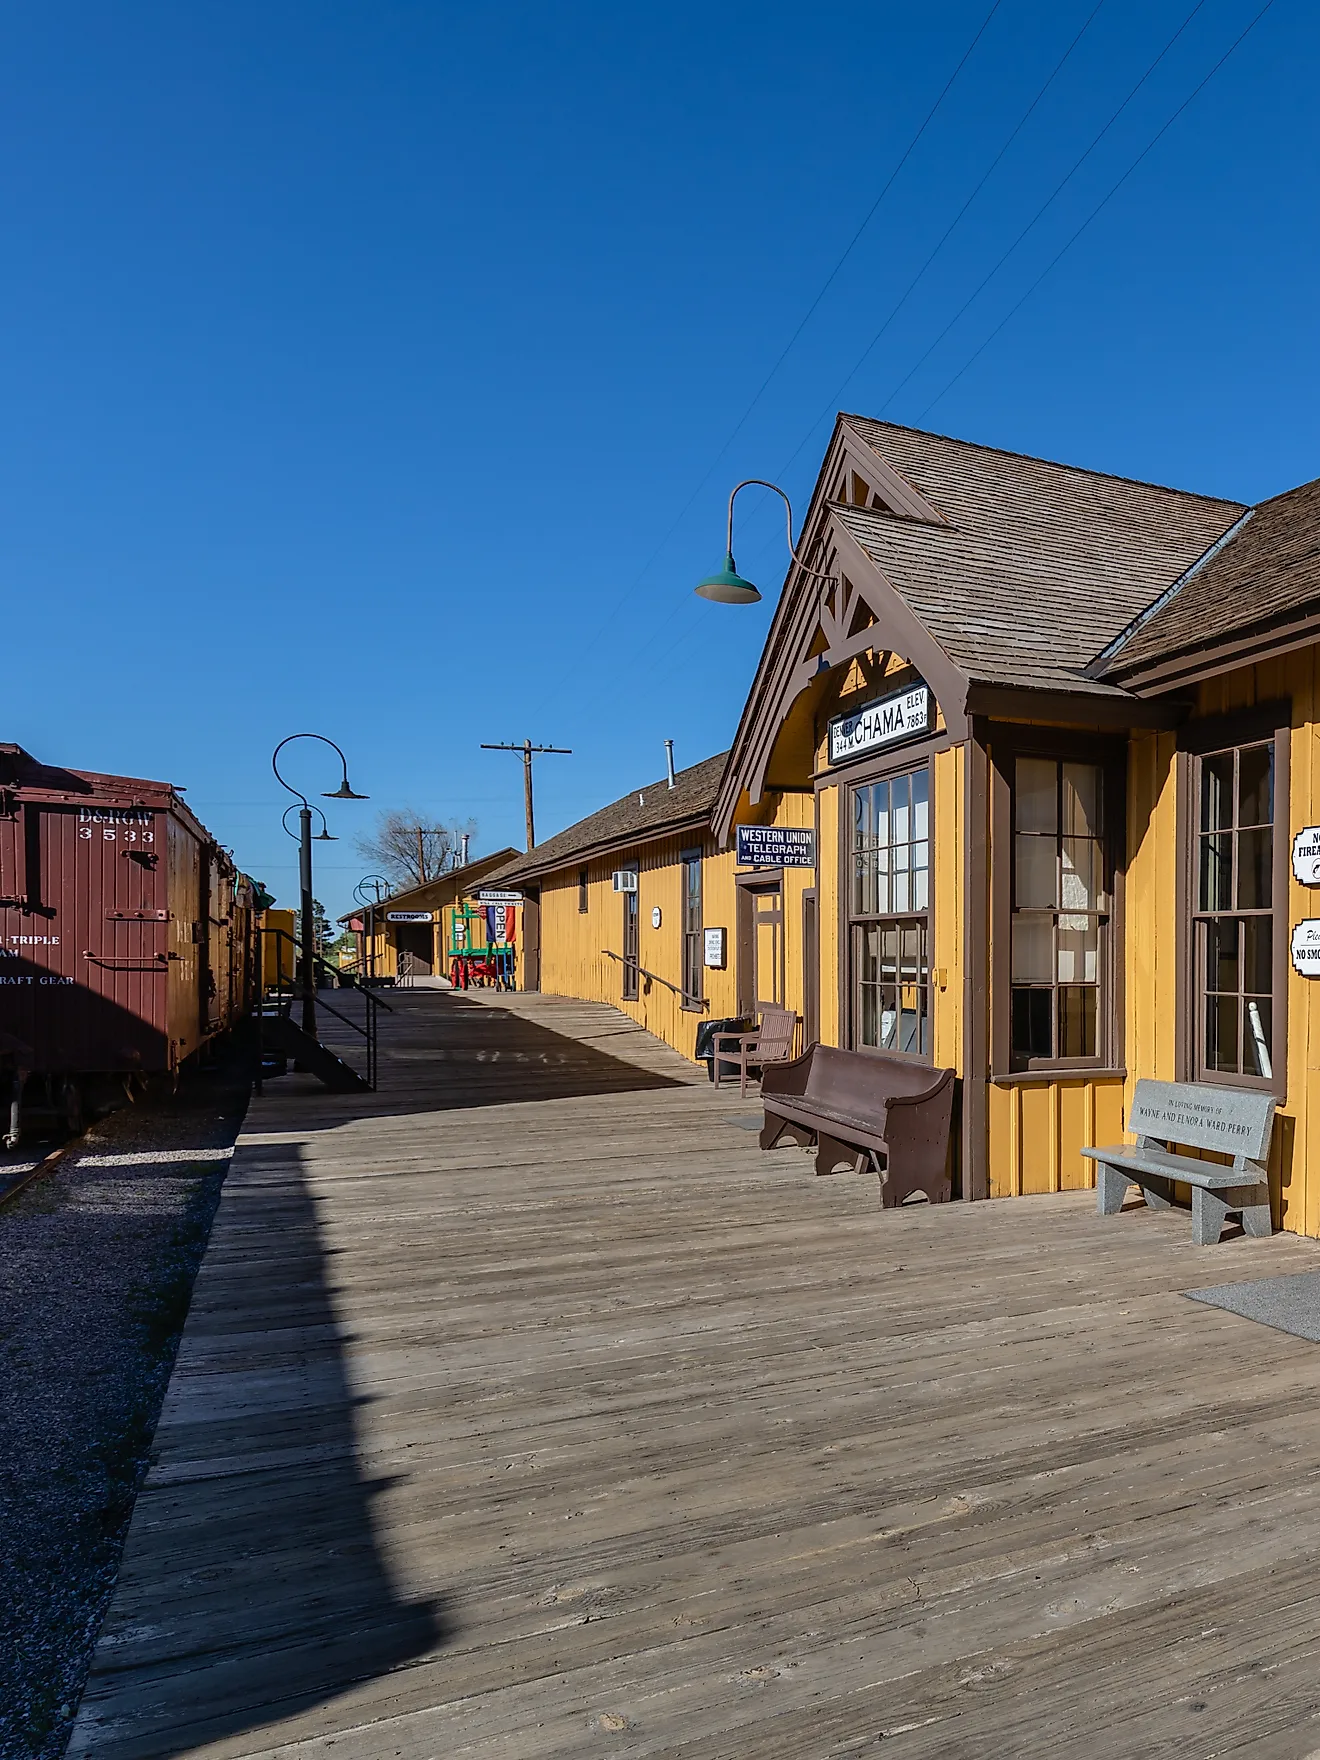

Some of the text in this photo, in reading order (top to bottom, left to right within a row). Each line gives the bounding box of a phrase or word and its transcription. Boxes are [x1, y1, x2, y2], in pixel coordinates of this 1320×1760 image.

[907, 690, 925, 709] ELEV.
[854, 703, 905, 745] CHAMA
[740, 829, 812, 844] WESTERN UNION
[747, 843, 807, 855] TELEGRAPH
[753, 854, 782, 863] CABLE
[783, 855, 812, 864] OFFICE
[496, 905, 505, 938] OPEN
[1296, 949, 1306, 960] NO
[39, 976, 74, 985] GEAR
[1139, 1107, 1253, 1137] WAYNE AND ELNORA WARD PERRY
